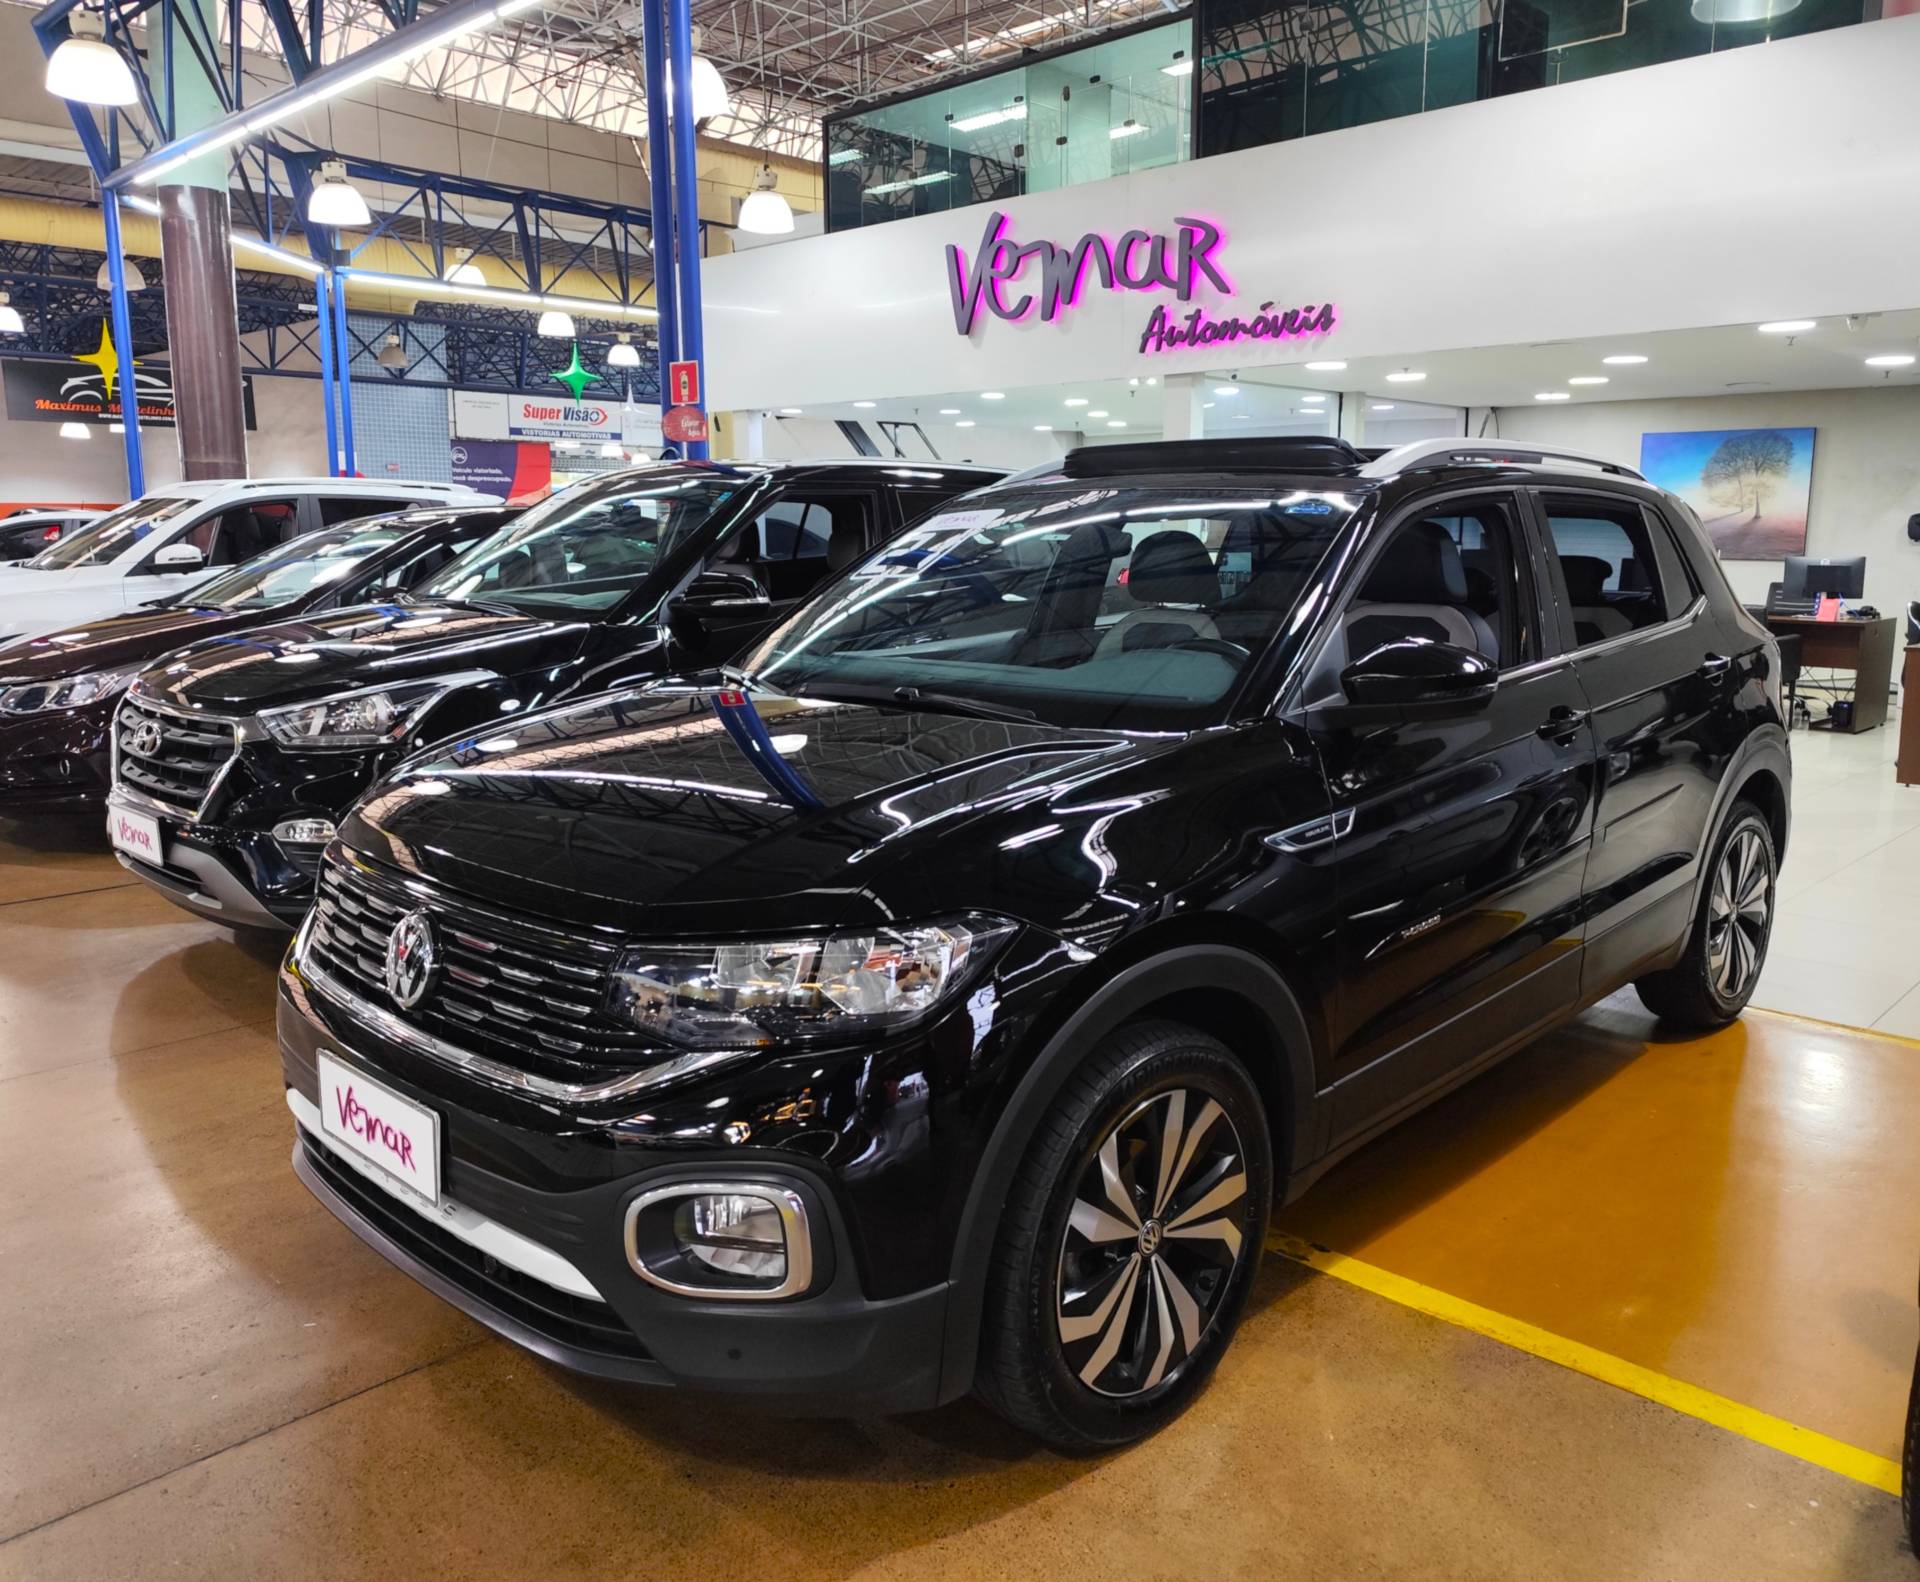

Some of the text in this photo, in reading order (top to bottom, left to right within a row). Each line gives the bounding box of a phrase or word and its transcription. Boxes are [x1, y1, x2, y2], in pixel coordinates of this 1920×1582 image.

[1138, 301, 1336, 353] Automóveis
[35, 399, 102, 412] Maximus
[521, 428, 611, 440] VISTORIAS AUTOMOTIVAS
